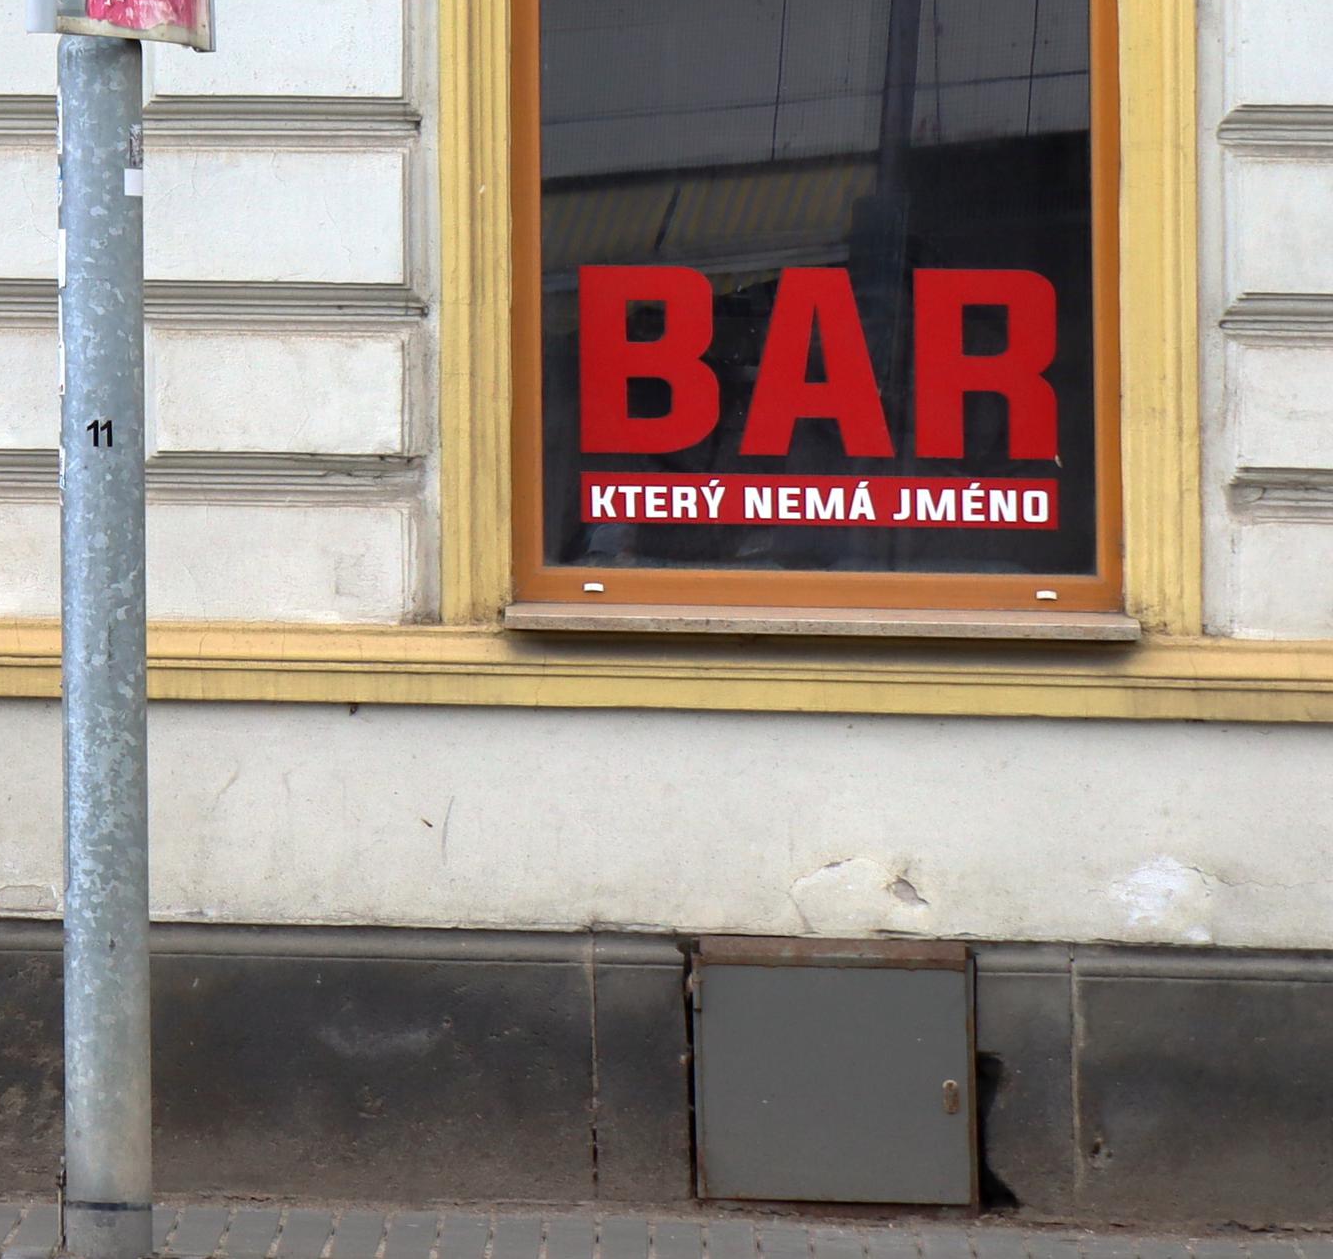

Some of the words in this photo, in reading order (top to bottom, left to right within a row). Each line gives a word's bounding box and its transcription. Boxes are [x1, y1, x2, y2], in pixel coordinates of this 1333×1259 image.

[579, 265, 1058, 460] BAR
[86, 420, 113, 447] 11
[590, 479, 725, 519] KTERÝ
[744, 481, 875, 520] NEMÁ
[893, 483, 1049, 523] JMÉNO
